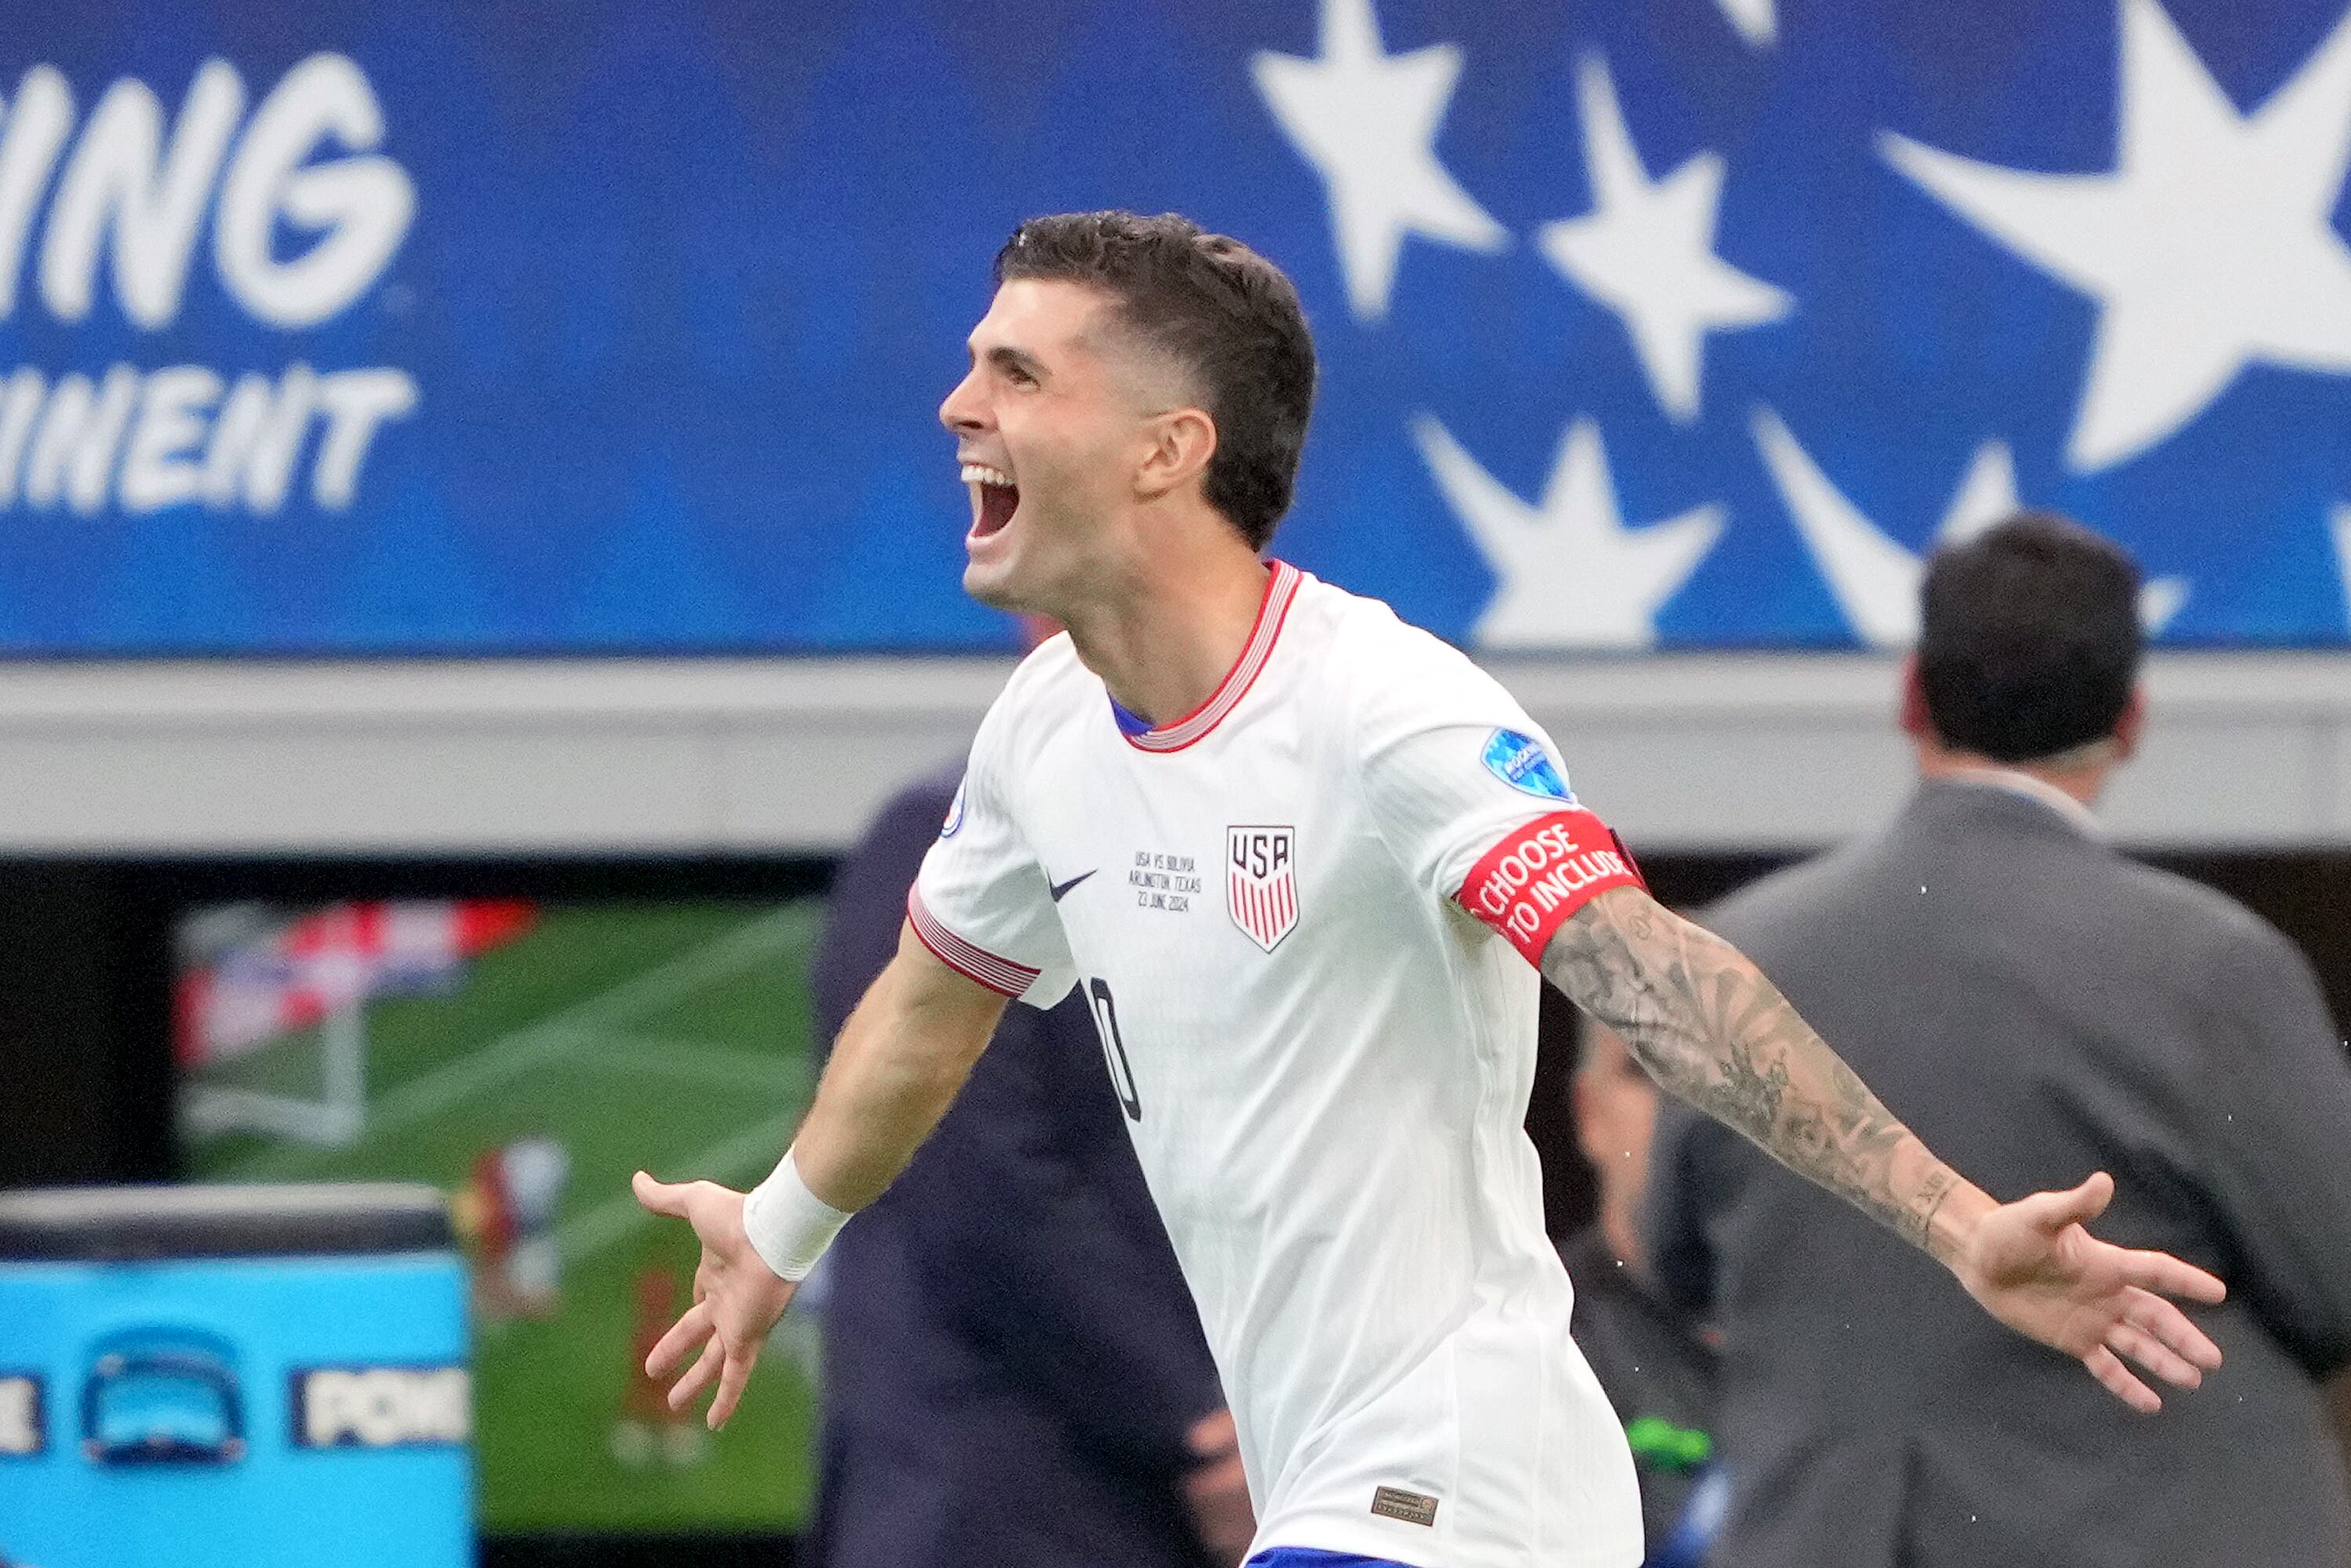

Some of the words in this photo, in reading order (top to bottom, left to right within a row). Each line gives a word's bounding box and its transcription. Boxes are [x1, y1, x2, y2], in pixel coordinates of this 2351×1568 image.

[1136, 851, 1150, 867] USA
[1233, 834, 1288, 879] USA
[1479, 823, 1579, 915] CHOOSE
[1506, 902, 1541, 943] TO
